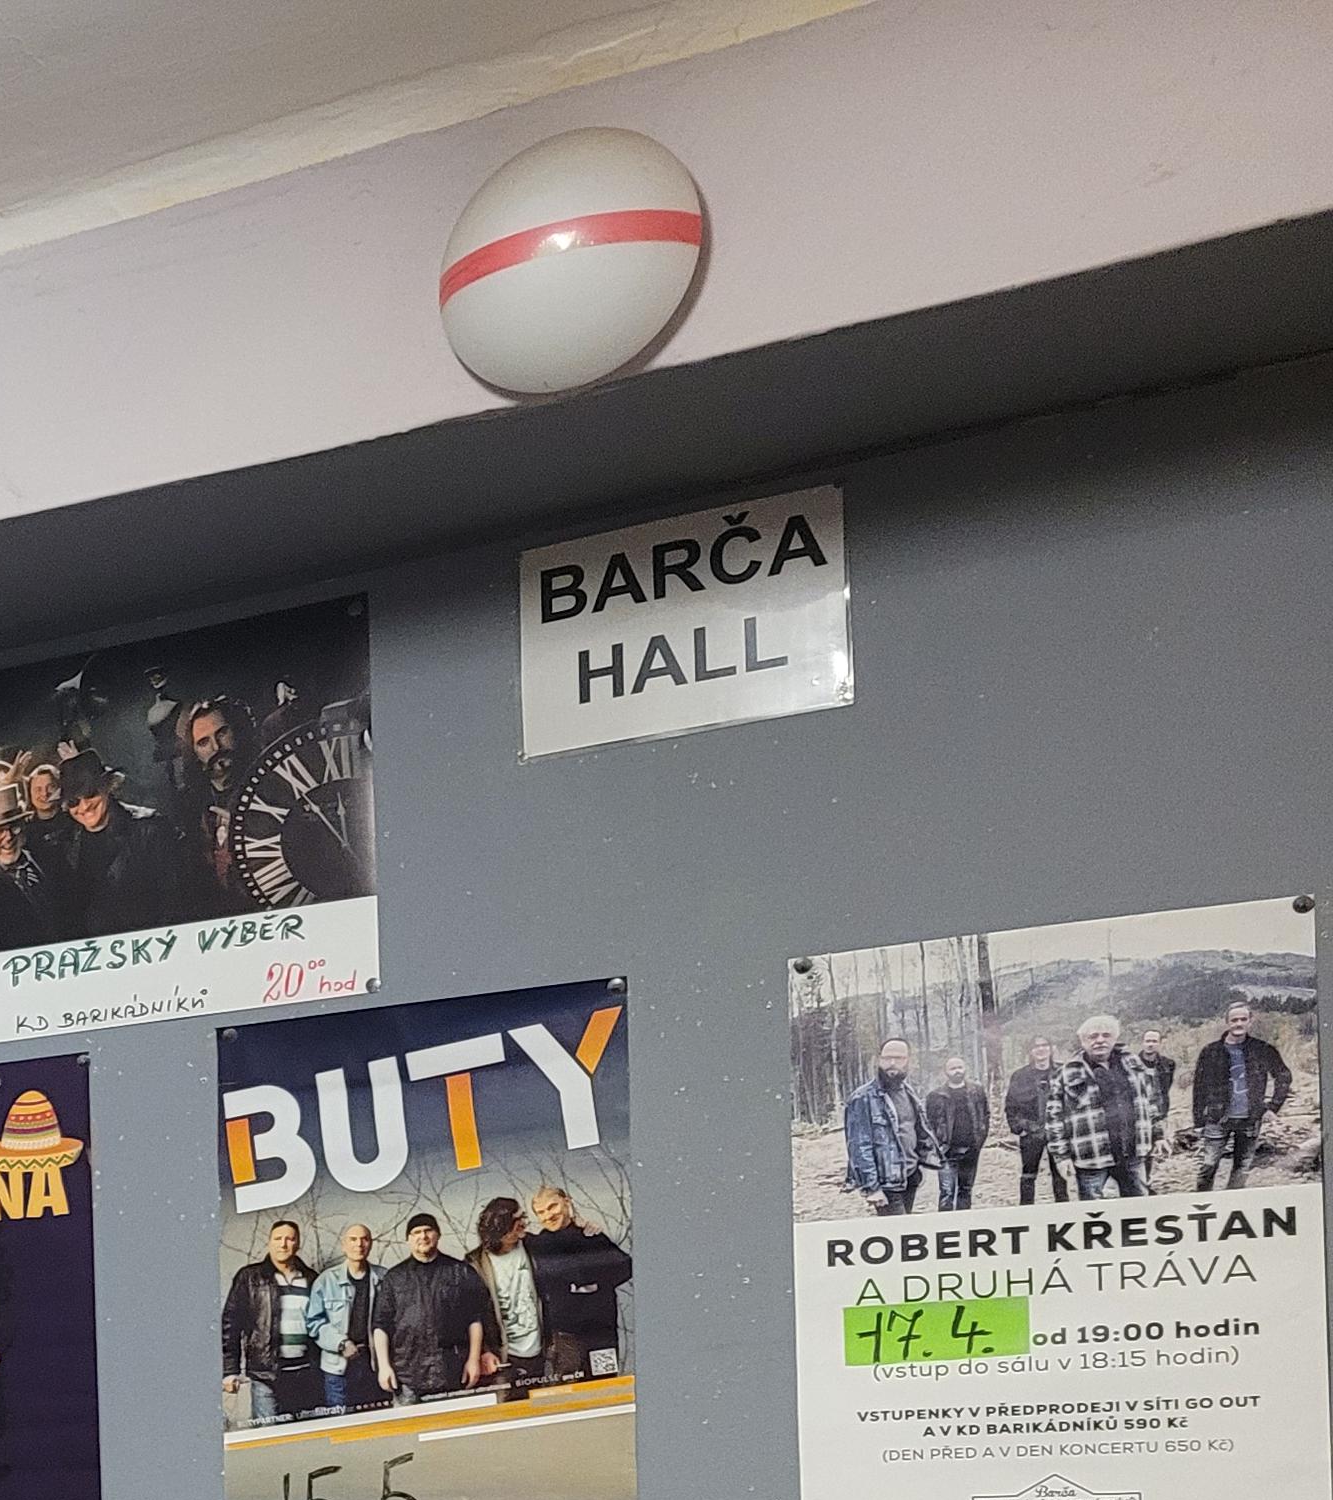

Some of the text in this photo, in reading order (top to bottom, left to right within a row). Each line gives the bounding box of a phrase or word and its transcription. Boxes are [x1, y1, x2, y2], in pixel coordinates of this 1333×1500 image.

[540, 511, 828, 624] BARČA
[578, 616, 788, 704] HALL
[2, 914, 305, 987] PRAŽSKÝ VÝBĚR
[16, 1015, 48, 1034] KD
[224, 1005, 622, 1213] BUTY
[827, 1204, 1298, 1267] ROBERT KŘESŤAN
[856, 1250, 1256, 1306] A DRUHÁ TRÁVA
[1033, 1318, 1260, 1346] od 19:00 hodin
[872, 1346, 1240, 1382] (vstup do sálu v 18:15 hodin)
[857, 1395, 1261, 1422] VSTUPENKY V PŘEDPRODEJI V SÍTI GO OUT
[923, 1415, 1189, 1437] A V KD BARIKÁDNÍKŮ 590 Kč
[882, 1438, 1234, 1464] (DEN PŘED A V DEN KONCERTU 650 Kč)
